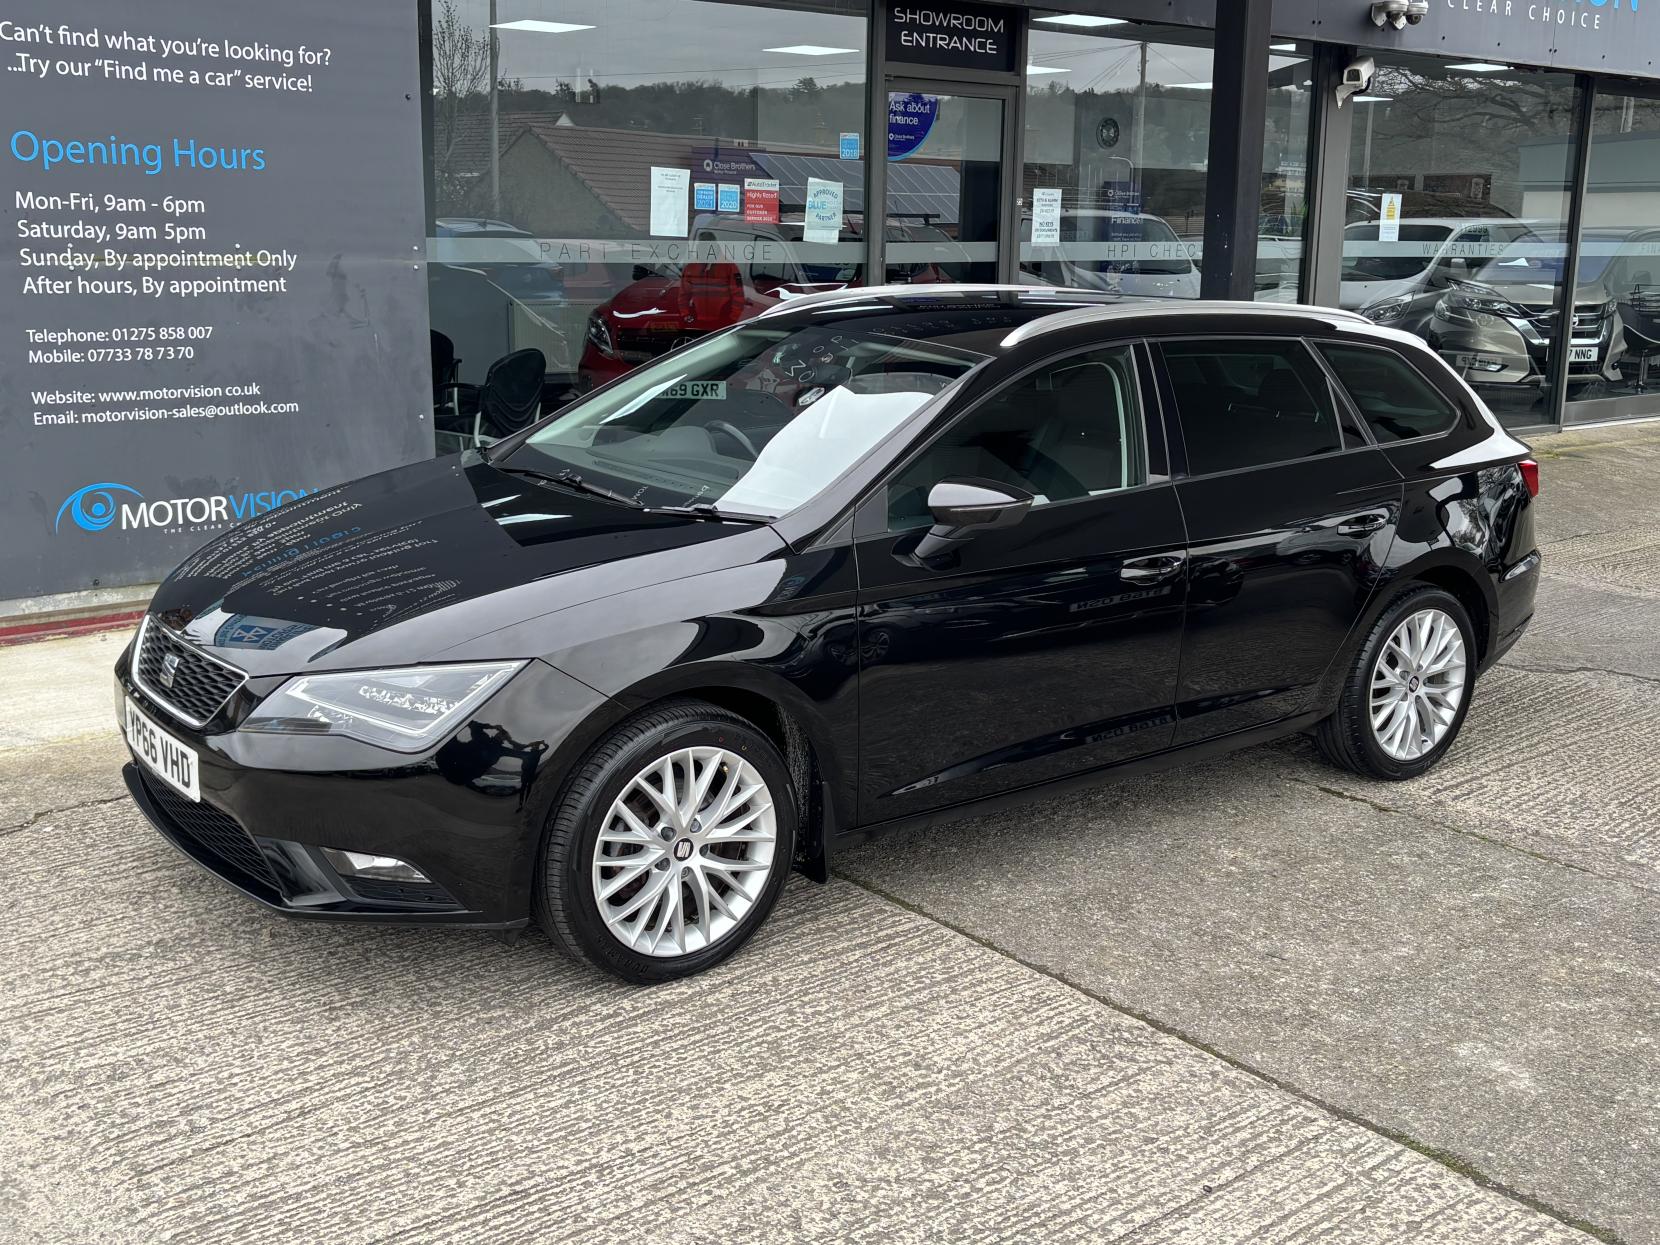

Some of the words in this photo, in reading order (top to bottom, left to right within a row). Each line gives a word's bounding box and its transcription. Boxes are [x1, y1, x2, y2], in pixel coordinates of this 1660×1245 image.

[894, 7, 1004, 34] SHOWROOM
[1529, 5, 1600, 29] CHOICE
[58, 25, 99, 47] find
[104, 31, 156, 52] what
[161, 37, 219, 58] you're
[224, 40, 294, 66] looking
[298, 47, 331, 66] for?
[901, 31, 997, 54] ENTRANCE
[56, 59, 91, 77] our
[153, 66, 184, 84] me
[188, 70, 200, 84] a
[245, 74, 313, 92] service!
[889, 101, 905, 112] Ask
[907, 102, 930, 113] about
[889, 114, 919, 125] finance
[10, 130, 163, 176] Opening
[173, 138, 266, 171] Hours
[714, 162, 730, 170] Close
[731, 163, 756, 171] Brothers
[15, 191, 100, 213] Mon-Fri,
[104, 194, 146, 212] 9am
[162, 196, 205, 216] 6pm
[808, 199, 827, 210] BLUE
[17, 219, 111, 243] Saturday,
[115, 222, 157, 240] 9am
[165, 224, 206, 242] 5pm
[20, 248, 99, 269] Sunday,
[104, 249, 127, 267] By
[133, 249, 253, 269] appointment
[257, 250, 297, 271] Only
[540, 243, 609, 260] PART
[631, 243, 772, 261] EXCHANGE
[1107, 244, 1137, 258] HPI
[1149, 244, 1203, 258] CHEC
[23, 276, 73, 295] After
[77, 276, 137, 296] hours,
[142, 277, 165, 297] By
[169, 276, 287, 296] appointment
[26, 328, 109, 345] Telephone:
[112, 328, 155, 341] 01275
[159, 327, 185, 340] 858
[188, 326, 213, 340] 007
[29, 349, 84, 364] Mobile:
[88, 349, 132, 362] 07733
[136, 348, 153, 360] 78
[1574, 349, 1592, 360] NNG
[31, 390, 95, 405] Website:
[691, 383, 719, 397] GXR
[33, 411, 79, 426] Email:
[82, 401, 299, 424] motorvision-sales@outlook.com
[121, 488, 319, 530] MOTORVISIO
[190, 524, 222, 532] CLEAR
[129, 708, 157, 765] YP66
[160, 737, 191, 789] VHD
